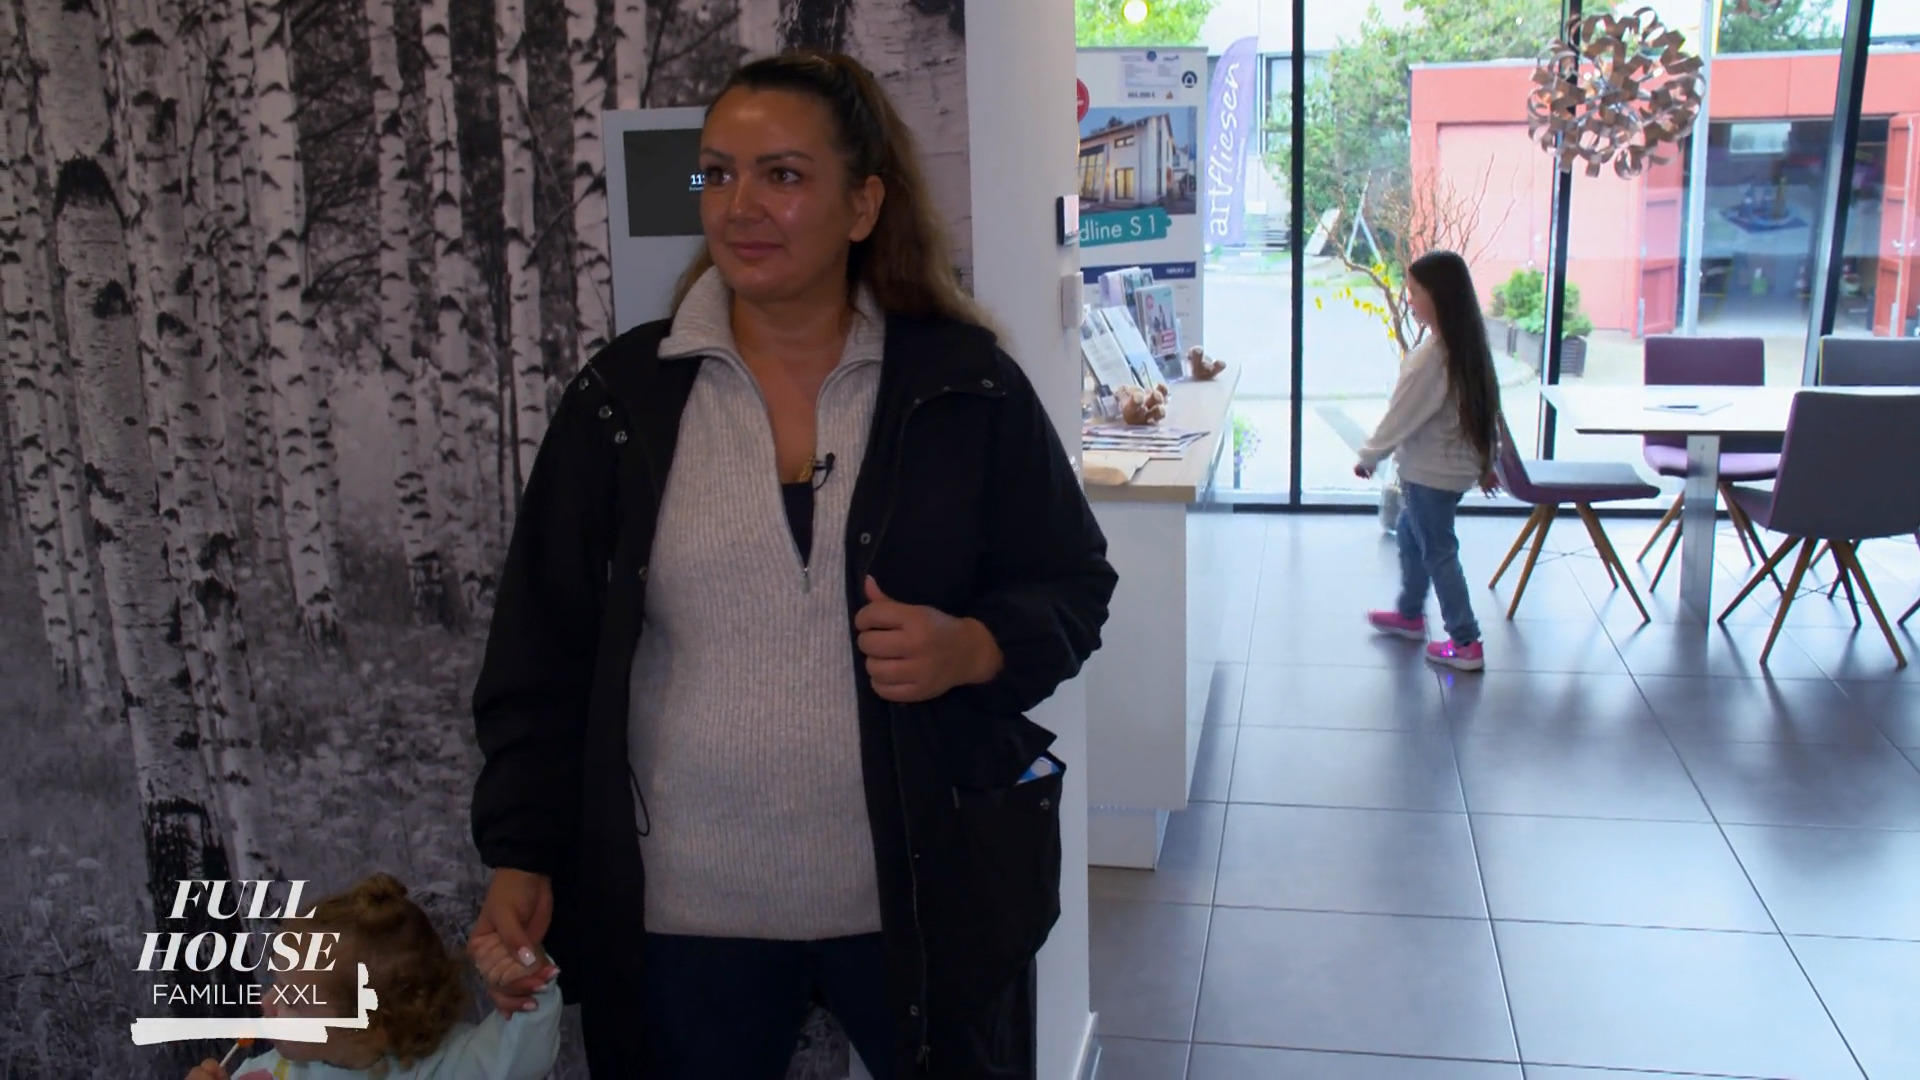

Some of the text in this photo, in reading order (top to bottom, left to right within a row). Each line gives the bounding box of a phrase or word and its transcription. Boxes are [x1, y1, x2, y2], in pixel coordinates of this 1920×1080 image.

[1209, 61, 1240, 237] artfliesen
[1130, 216, 1141, 236] S
[1149, 214, 1155, 234] 1
